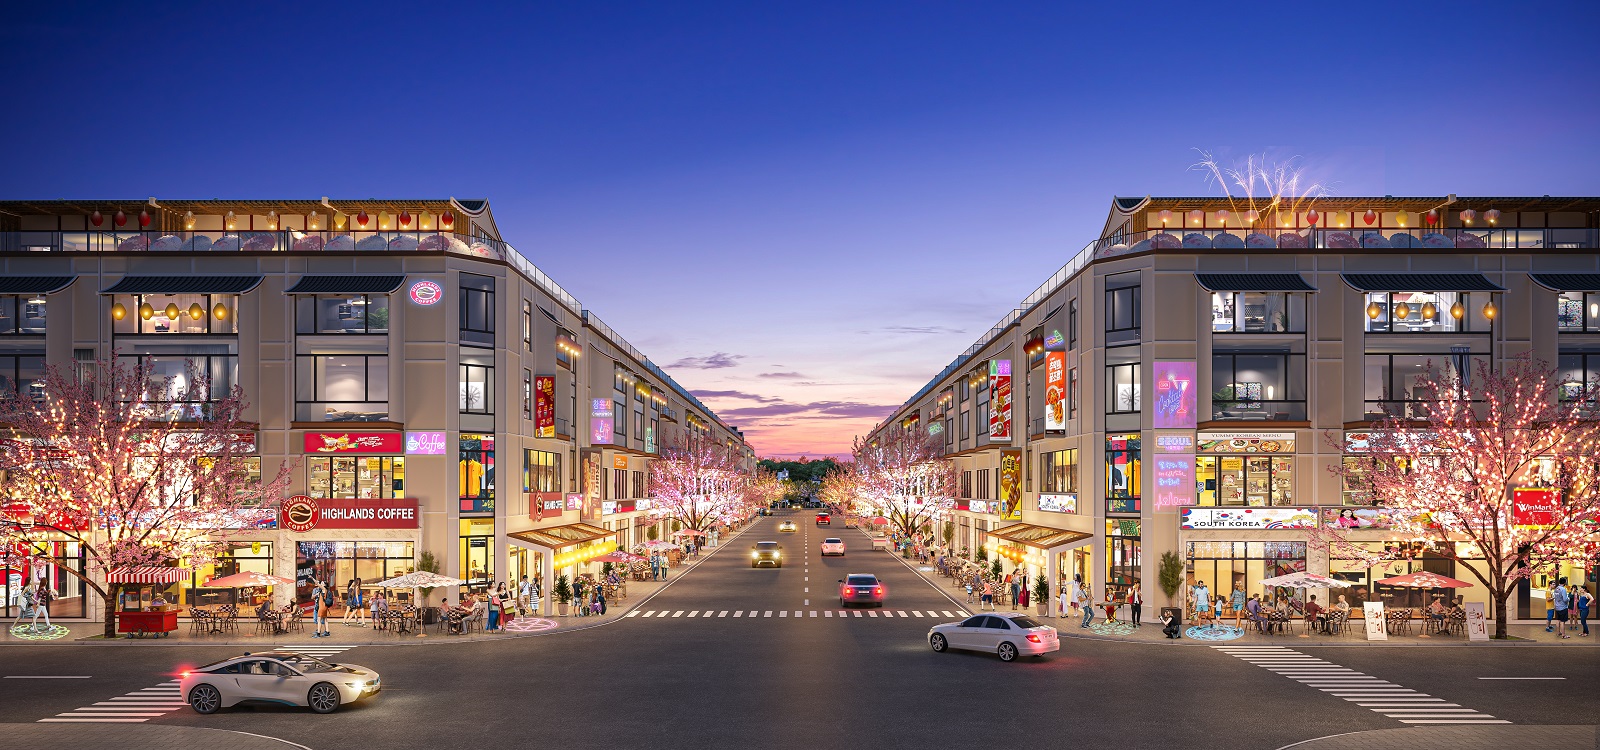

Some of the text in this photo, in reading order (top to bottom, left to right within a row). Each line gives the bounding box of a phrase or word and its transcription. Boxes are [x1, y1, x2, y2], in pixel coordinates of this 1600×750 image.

[419, 433, 446, 453] Coffee
[1158, 437, 1192, 446] SEOUL
[284, 496, 317, 512] HIGHLANDS
[322, 508, 414, 519] HIGHLANDS COFFEE
[287, 521, 314, 531] COFFEE
